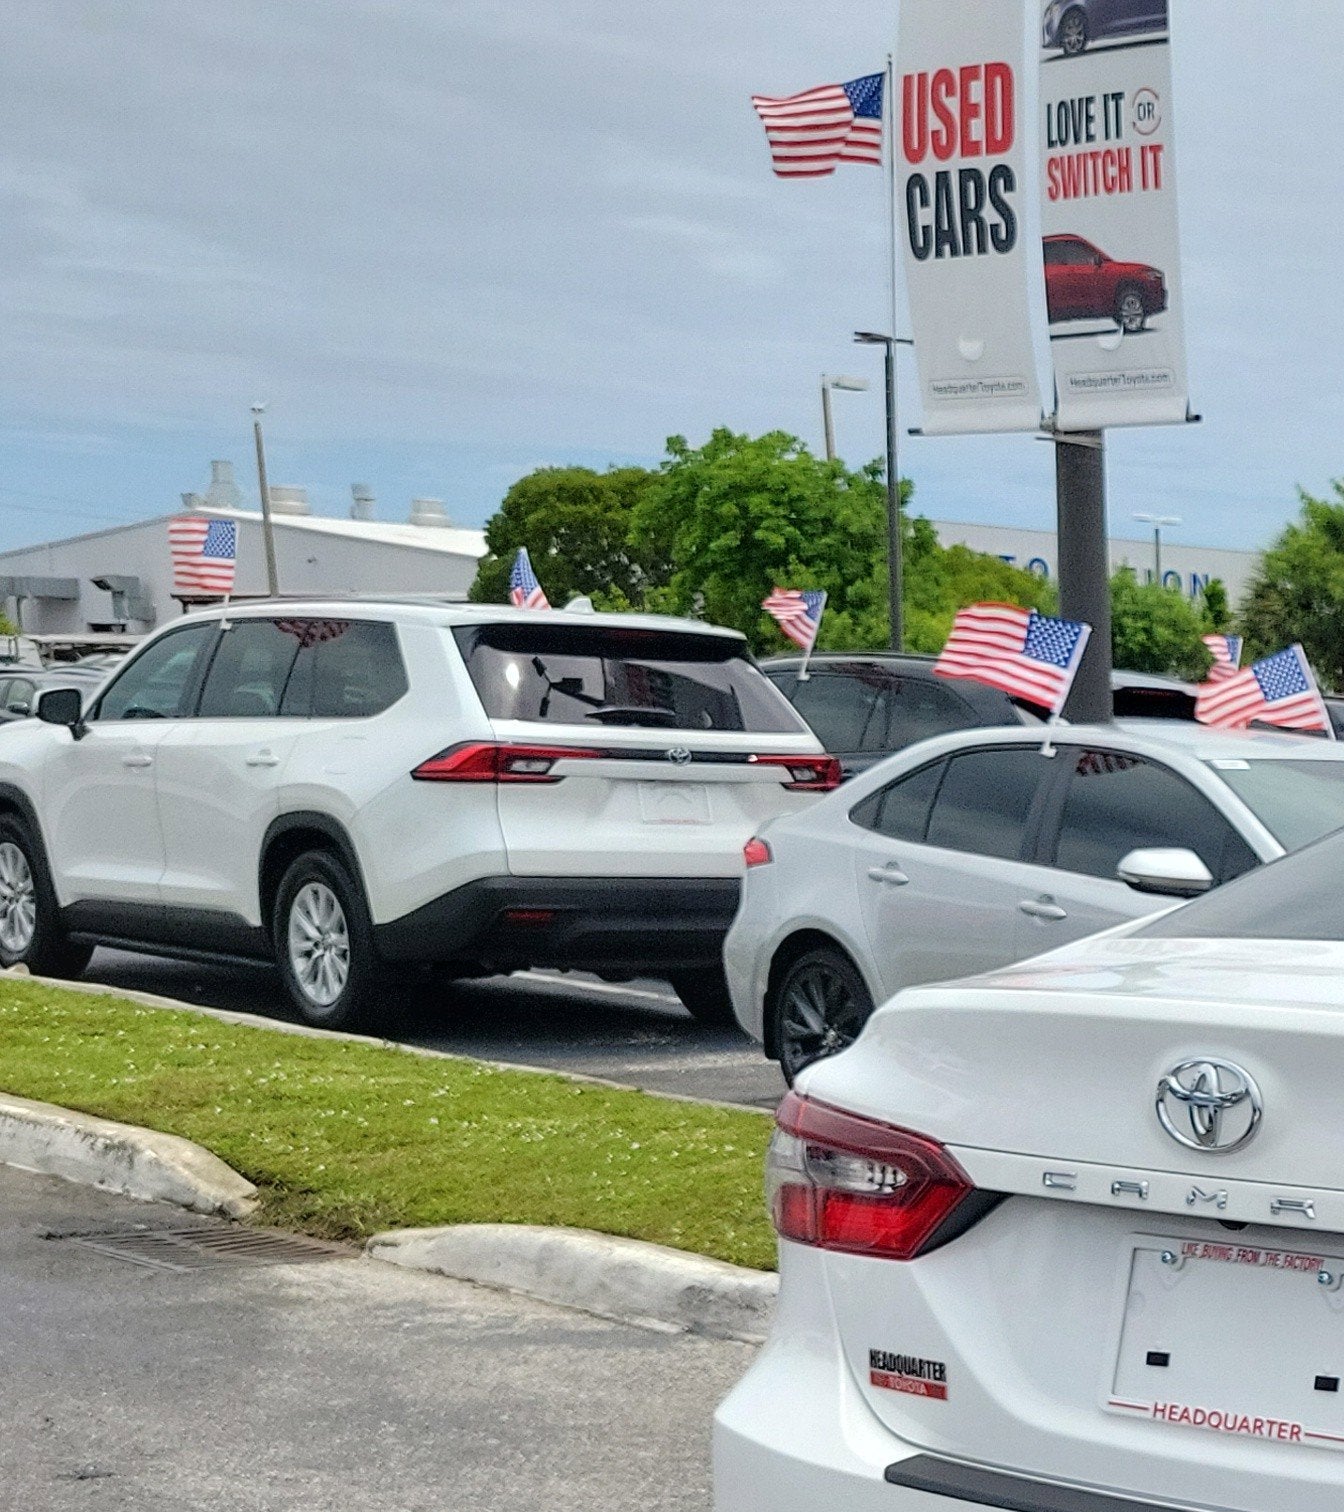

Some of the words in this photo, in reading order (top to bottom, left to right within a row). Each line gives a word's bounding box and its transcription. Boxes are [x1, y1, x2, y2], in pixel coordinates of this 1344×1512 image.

[902, 62, 1015, 164] USED
[1046, 96, 1096, 149] LOVE
[1103, 91, 1125, 140] IT
[1137, 102, 1155, 121] OR
[1047, 146, 1133, 201] SWITCH
[1140, 144, 1163, 191] IT
[906, 164, 1018, 261] CARS
[869, 1348, 947, 1382] HEADQUARTER
[1152, 1401, 1302, 1441] HEADQUARTER
